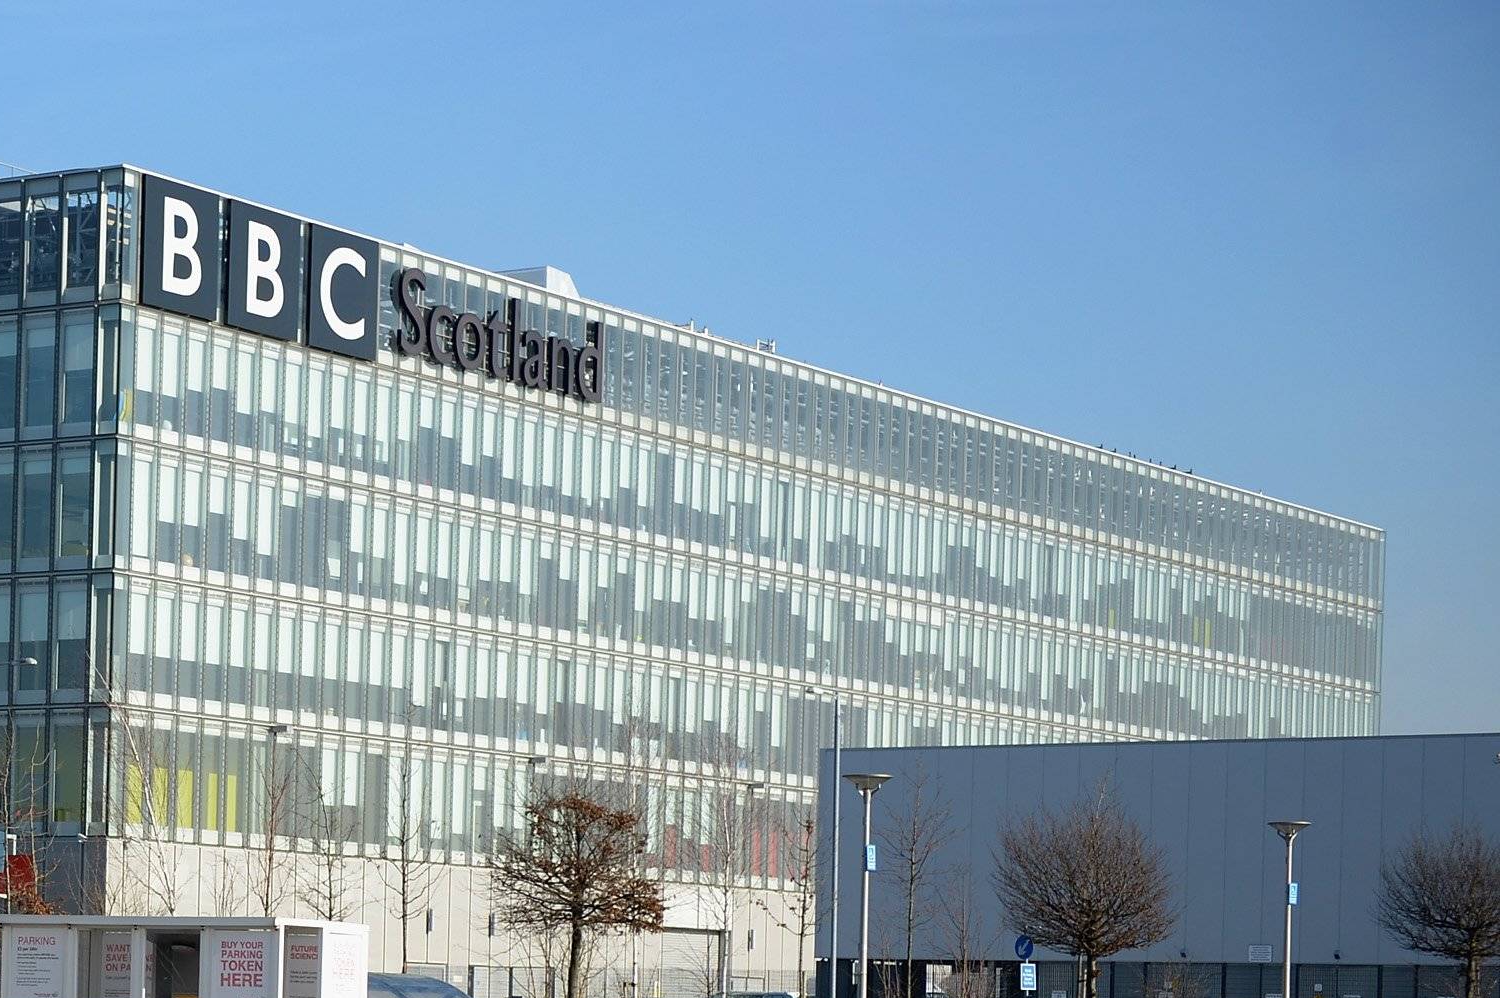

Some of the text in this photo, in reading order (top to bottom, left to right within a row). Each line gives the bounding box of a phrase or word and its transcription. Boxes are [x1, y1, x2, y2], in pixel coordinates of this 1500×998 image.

[161, 196, 602, 402] BBC Scotland
[18, 936, 56, 945] PARKING
[106, 944, 131, 952] WANT
[221, 941, 263, 949] BUY YOUR
[290, 945, 318, 953] FUTURE
[106, 953, 128, 961] SAVE
[221, 950, 263, 959] PARKING
[106, 963, 118, 971] ON
[221, 960, 263, 971] TOKEN
[220, 973, 263, 987] HERE
